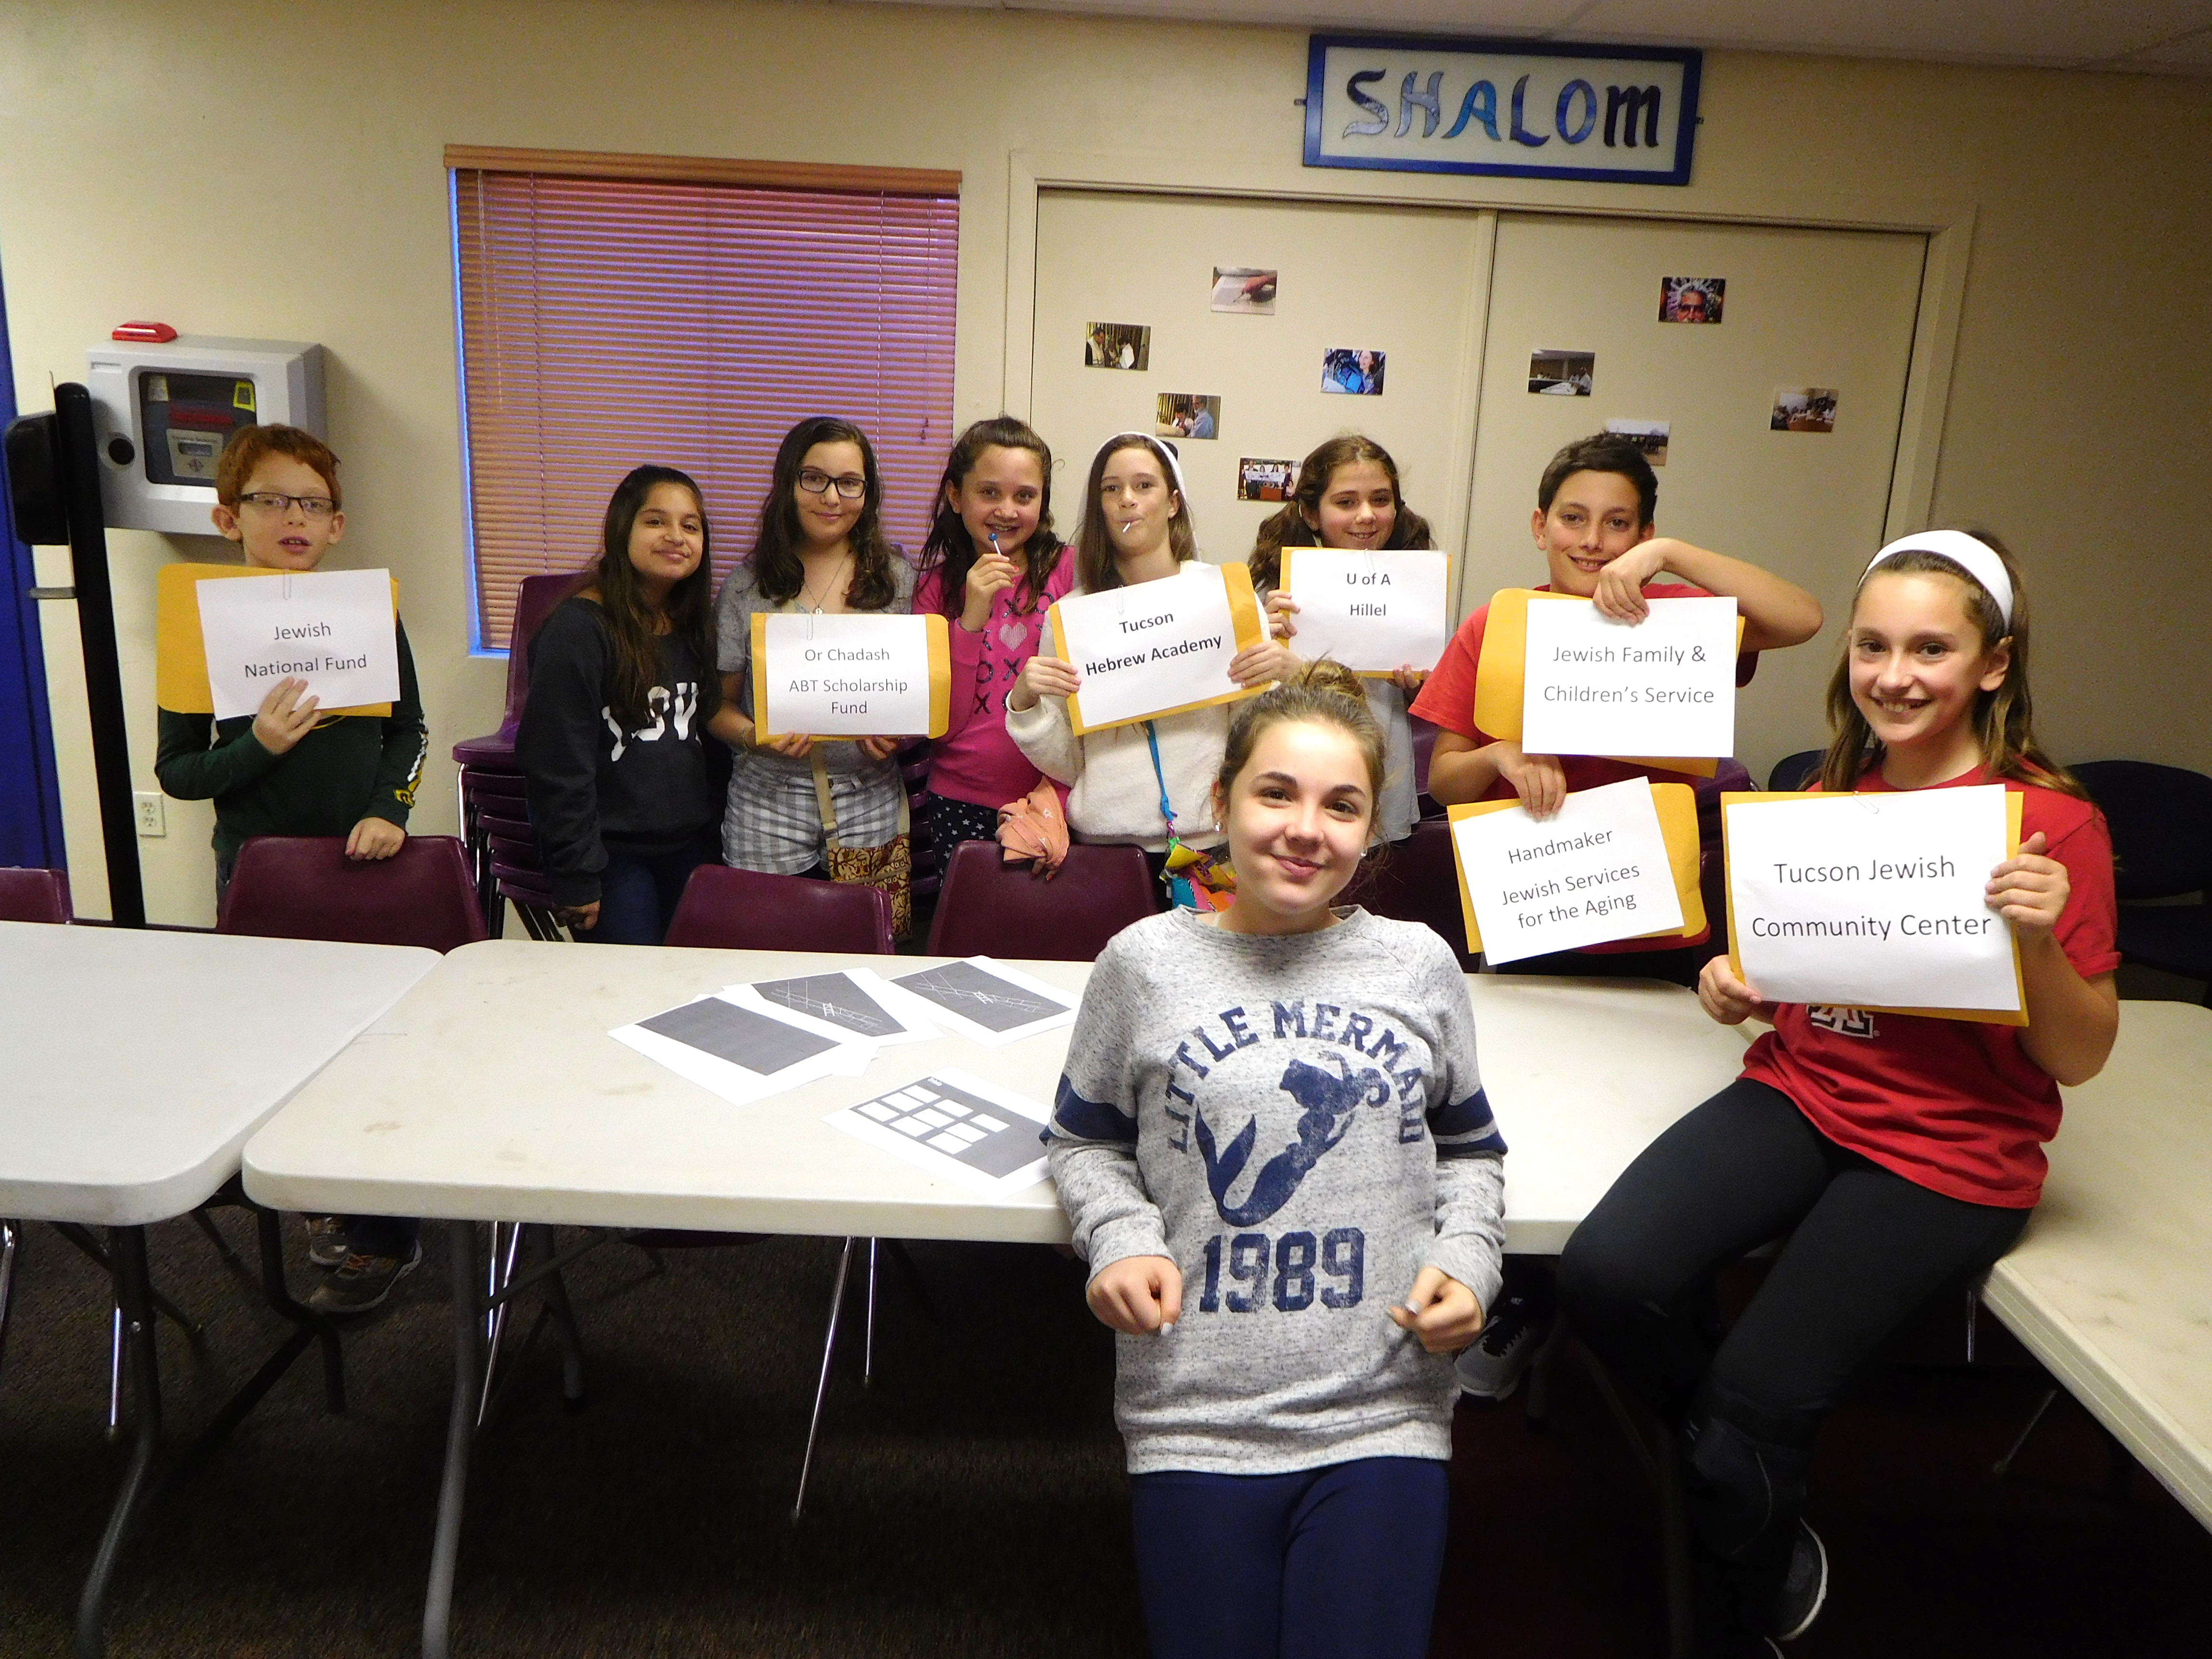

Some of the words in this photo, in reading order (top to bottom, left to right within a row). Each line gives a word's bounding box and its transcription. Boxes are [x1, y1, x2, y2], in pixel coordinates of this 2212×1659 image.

[1346, 573, 1357, 585] U
[1362, 573, 1377, 585] of
[1381, 574, 1391, 586] A
[1350, 603, 1386, 616] Hillel
[274, 622, 331, 640] Jewish
[1118, 613, 1174, 634] Tucson
[805, 649, 823, 661] Or
[828, 648, 890, 661] Chadash
[1085, 653, 1145, 676] Hebrew
[1151, 636, 1221, 661] Academy
[1553, 646, 1614, 662] Jewish
[1623, 646, 1684, 666] Family
[1692, 646, 1706, 662] &
[245, 657, 319, 680] National
[325, 654, 367, 671] Fund
[789, 680, 818, 692] ABT
[823, 678, 907, 695] Scholarship
[1544, 685, 1638, 703] Children’s
[1645, 687, 1714, 703] Service
[832, 700, 867, 714] Fund
[1508, 830, 1612, 864] Handmaker
[1773, 864, 1859, 884] Tucson
[1869, 855, 1955, 880] Jewish
[1503, 879, 1560, 908] Jewish
[1565, 866, 1640, 891] Services
[1518, 913, 1543, 929] for
[1549, 906, 1579, 922] the
[1586, 894, 1637, 916] Aging
[1752, 915, 1891, 941] Community
[1900, 912, 1992, 936] Center
[1165, 1005, 1260, 1154] LITTLE
[1269, 1000, 1426, 1144] MERMAID
[1199, 1227, 1364, 1313] 1989
